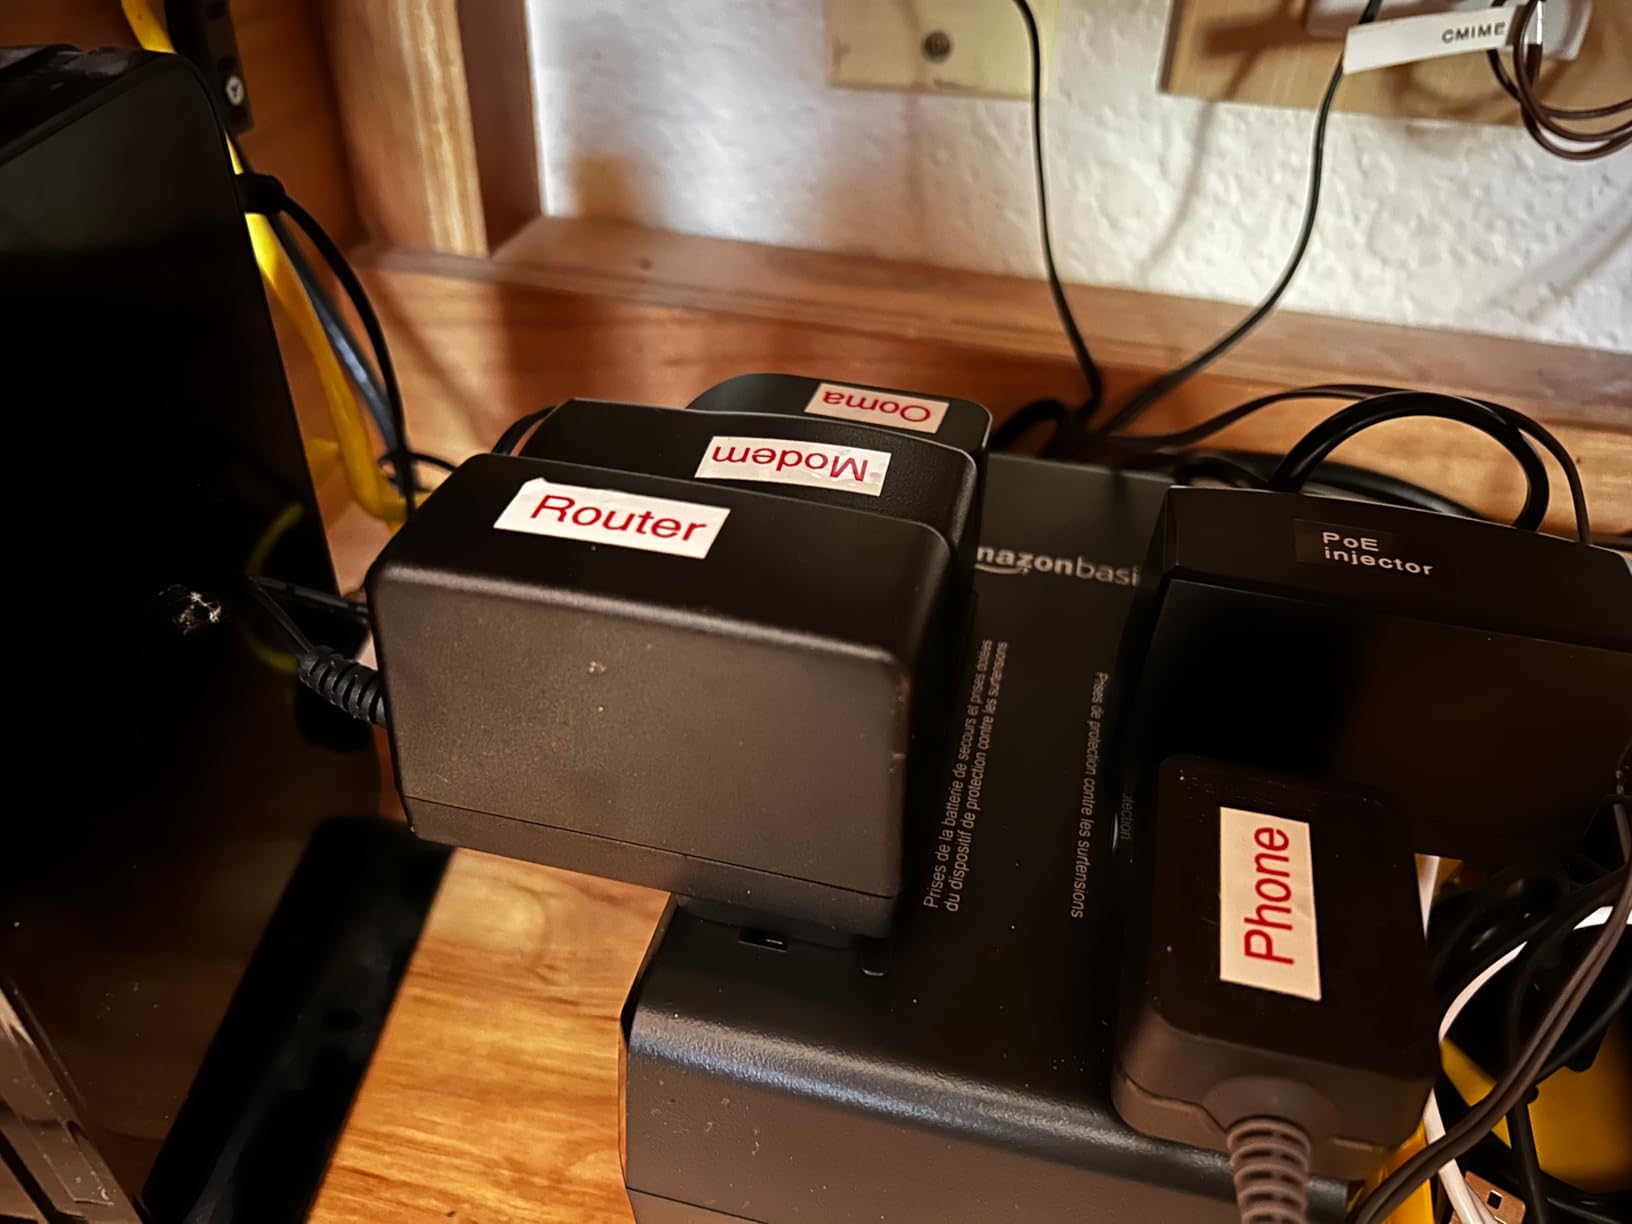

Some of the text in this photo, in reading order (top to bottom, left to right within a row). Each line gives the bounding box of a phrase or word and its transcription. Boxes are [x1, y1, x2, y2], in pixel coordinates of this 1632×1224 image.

[1442, 22, 1506, 43] CMIME
[824, 390, 932, 423] Ooma
[711, 446, 868, 481] Modem
[531, 494, 707, 541] Router
[1321, 531, 1380, 552] PoE
[1323, 546, 1434, 575] injector
[982, 698, 998, 714] les
[958, 717, 976, 761] secours
[977, 715, 994, 750] contre
[1085, 720, 1102, 776] protection
[952, 763, 967, 778] de
[965, 751, 987, 811] protection
[941, 780, 964, 826] batterie
[1080, 777, 1096, 816] contre
[937, 829, 954, 842] la
[960, 812, 976, 829] de
[1078, 818, 1095, 838] les
[933, 844, 951, 862] de
[948, 829, 970, 890] dispositif
[923, 865, 947, 908] Prises
[1070, 840, 1092, 918] surtensions
[1244, 828, 1294, 965] Phone
[943, 892, 960, 912] du
